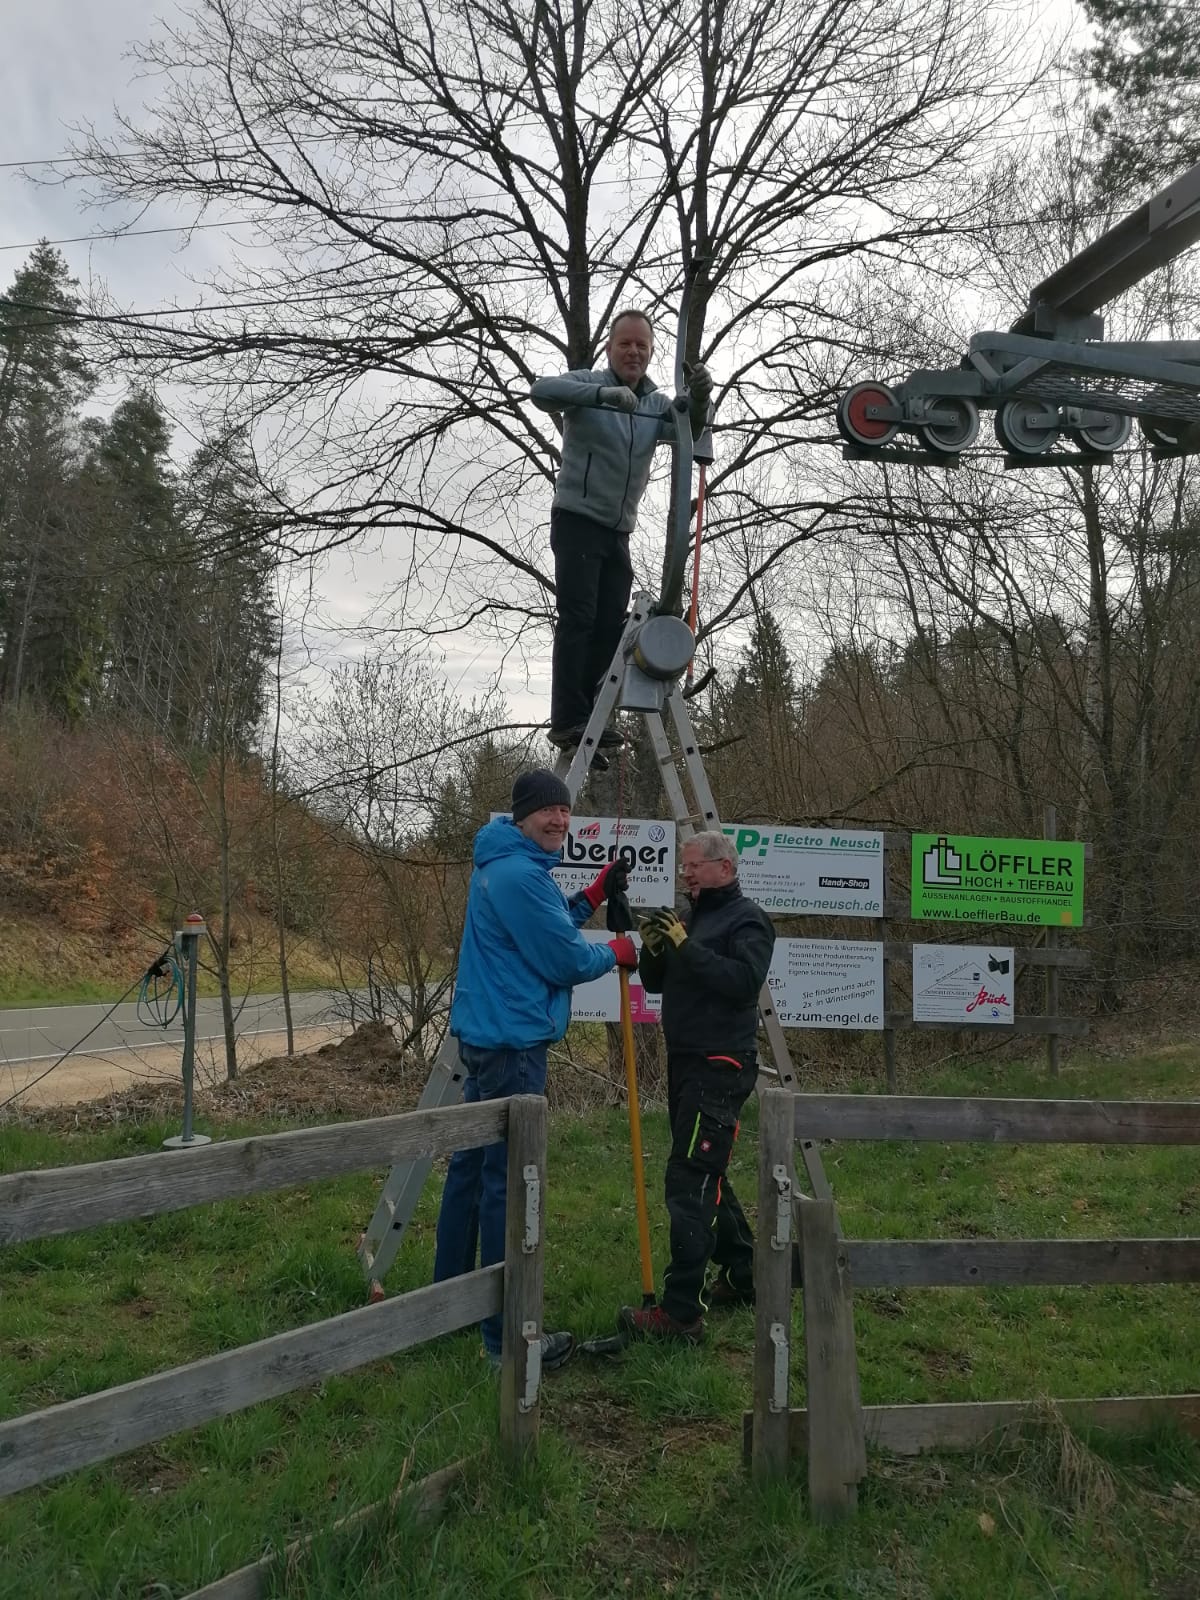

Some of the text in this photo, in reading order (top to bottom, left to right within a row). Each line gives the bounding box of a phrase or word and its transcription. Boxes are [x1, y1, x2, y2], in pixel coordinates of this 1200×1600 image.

[774, 834, 880, 849] Electro Neusch
[966, 850, 1073, 877] LÖFFLER
[627, 875, 660, 883] straße
[821, 878, 868, 888] Handy-Shop
[965, 876, 1074, 892] HOCH + TIEFBAU
[751, 895, 880, 912] p-electro-neusch.de
[922, 892, 1073, 907] AUSSENANLAGEN BAUSTOFFHANDEL
[922, 908, 1041, 923] www.LoefflerBau.de
[803, 991, 813, 999] Sie
[815, 987, 840, 997] finden
[841, 984, 855, 992] uns
[803, 1001, 812, 1009] 2x
[571, 1009, 607, 1017] eber.de
[776, 1012, 879, 1025] er-zum-engel.de
